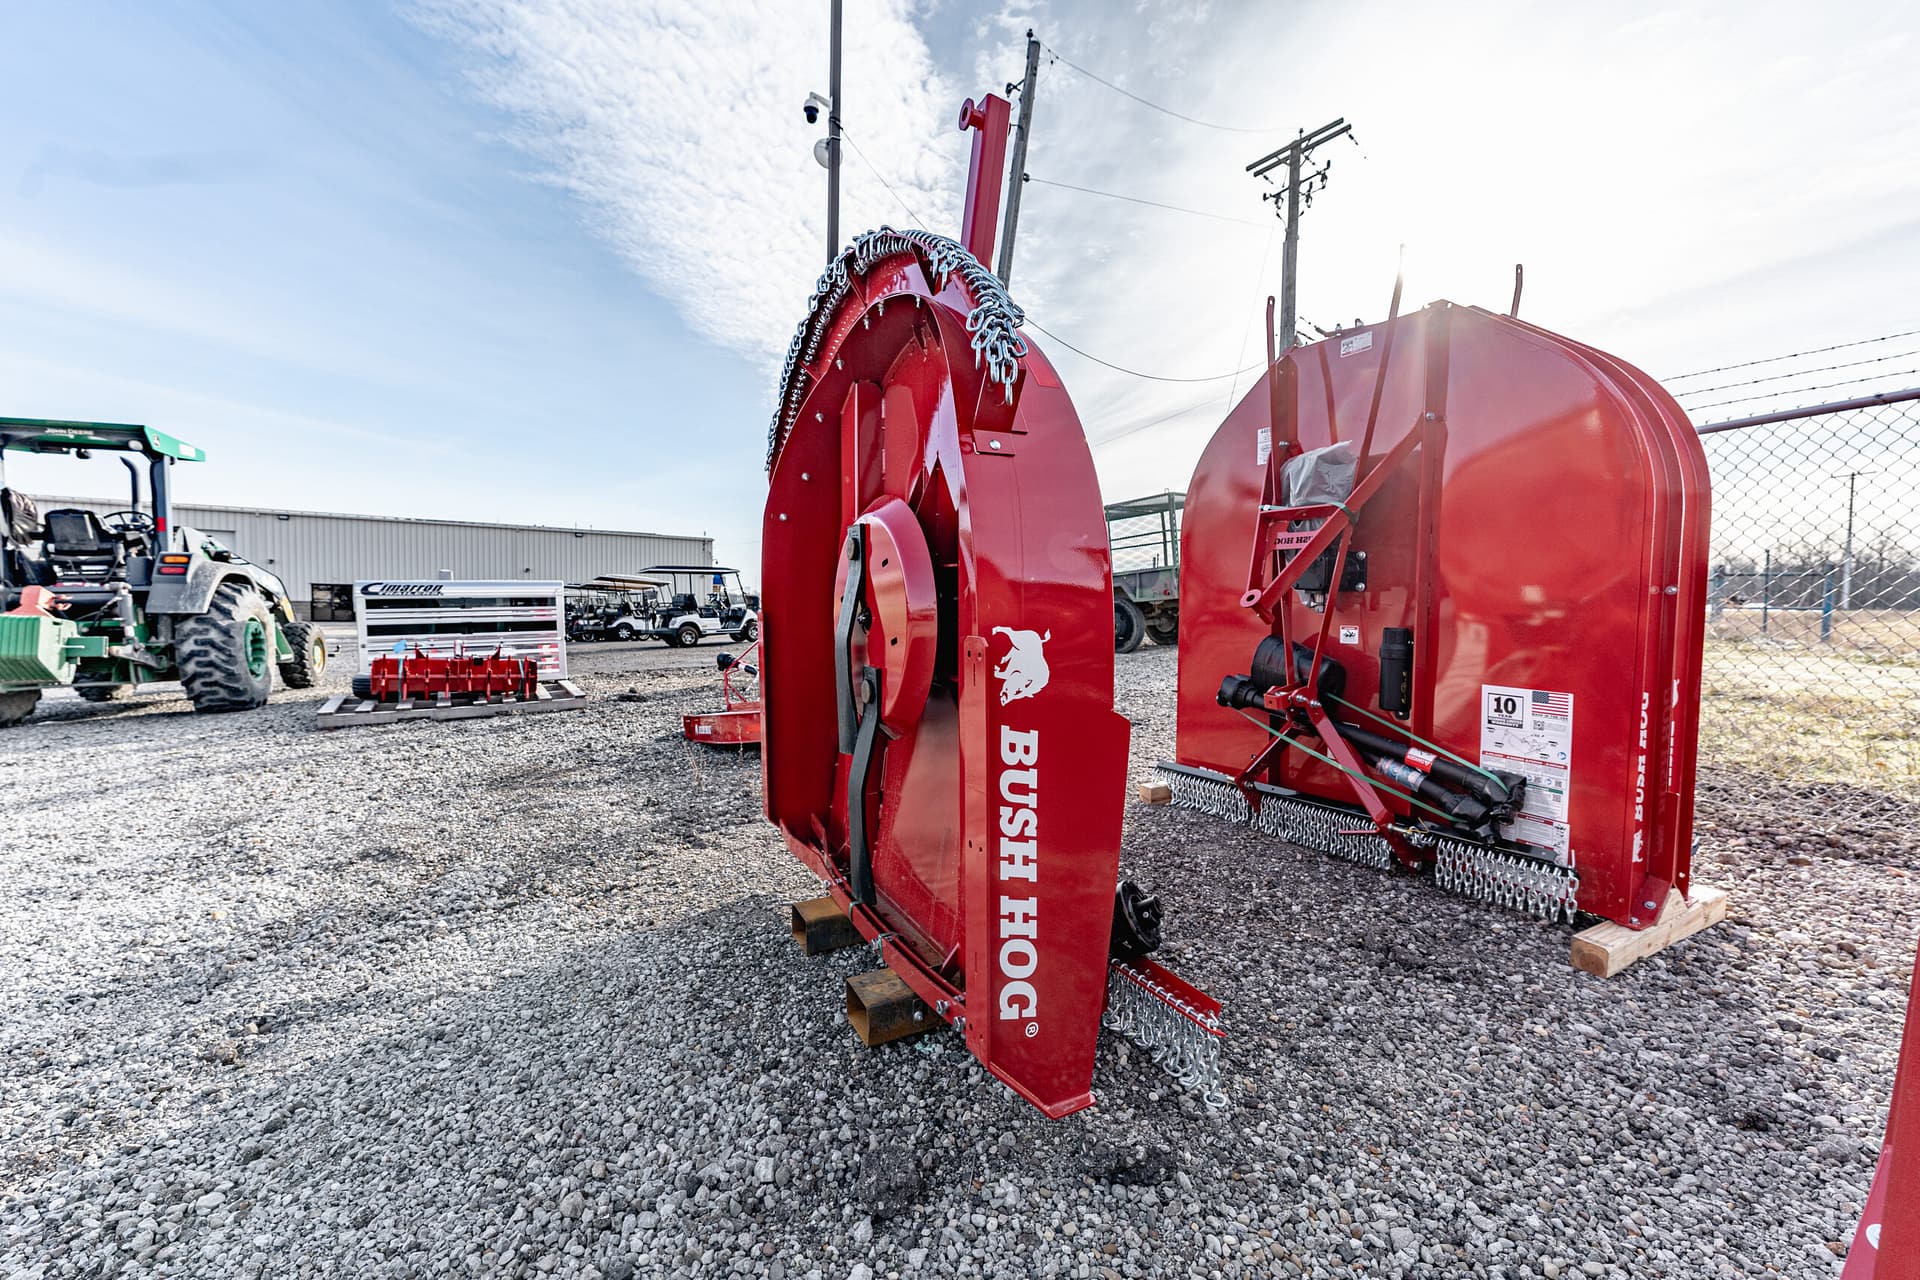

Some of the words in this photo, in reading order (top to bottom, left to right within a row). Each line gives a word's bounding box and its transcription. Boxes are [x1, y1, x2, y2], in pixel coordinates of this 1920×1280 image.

[360, 582, 444, 596] Cimarron
[1494, 696, 1516, 714] 10
[999, 724, 1038, 882] BUSH
